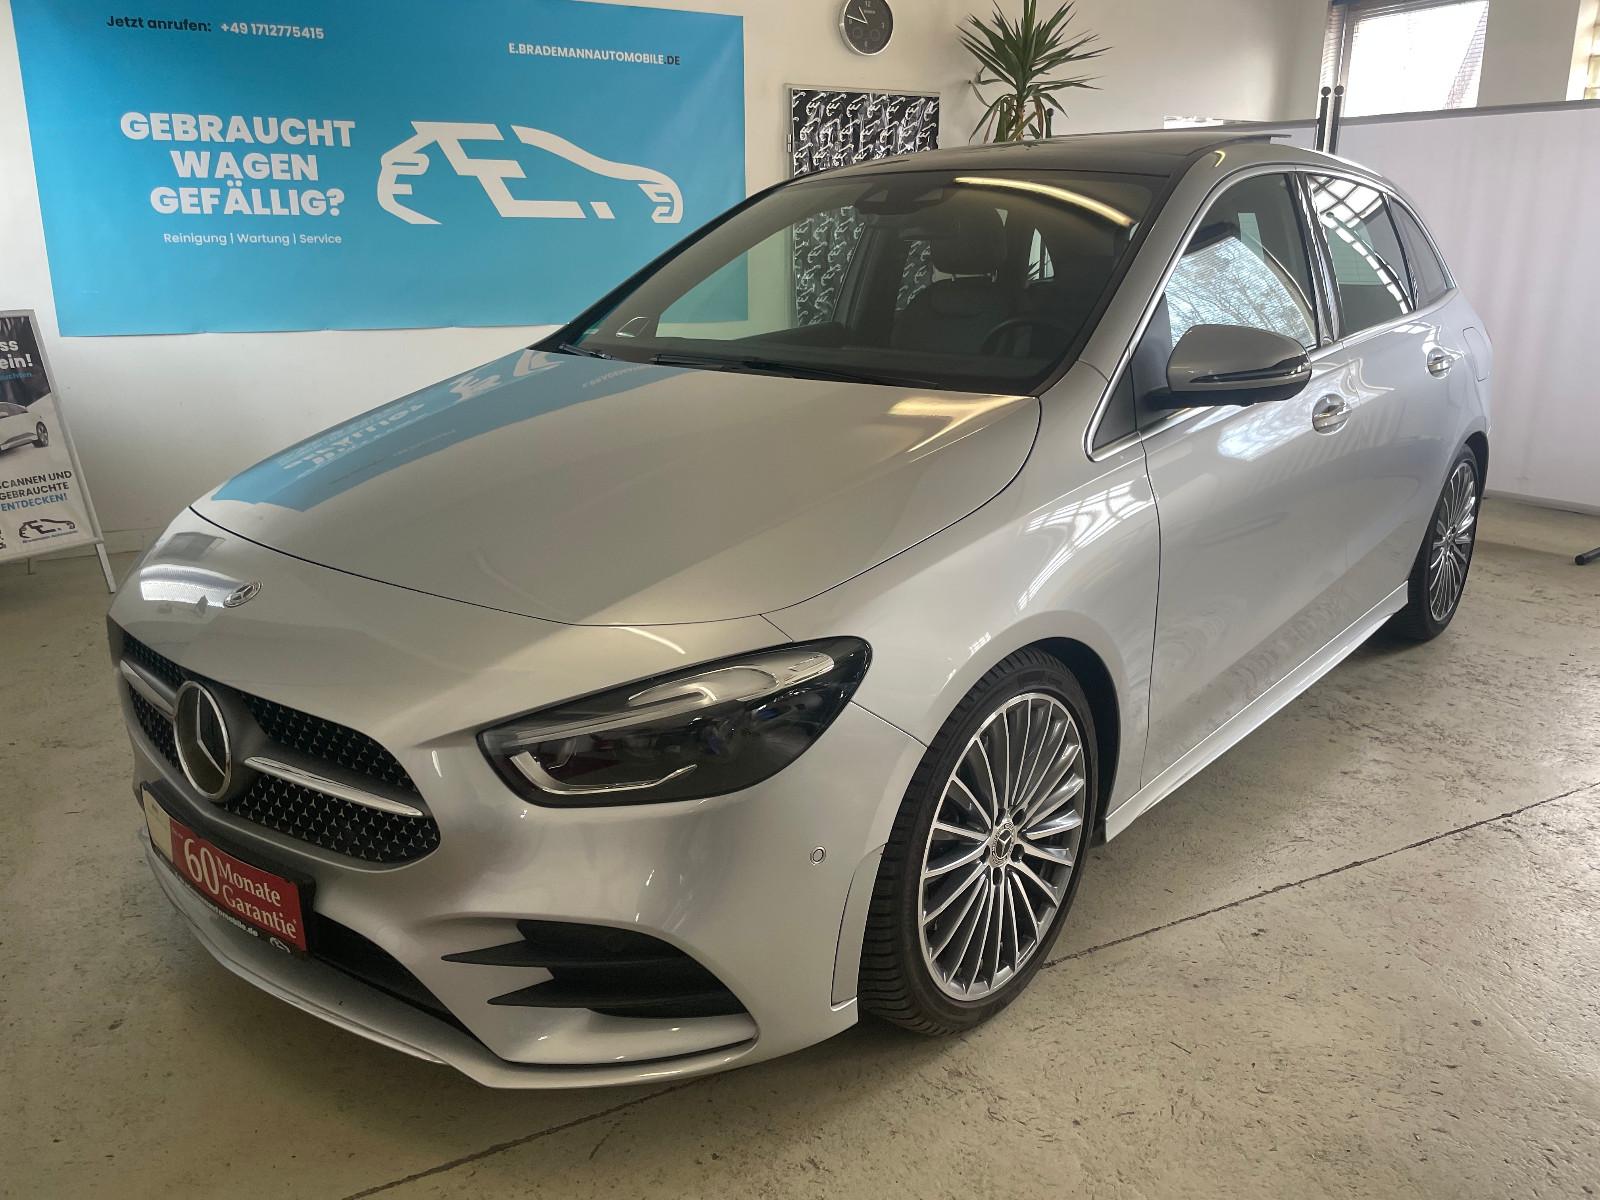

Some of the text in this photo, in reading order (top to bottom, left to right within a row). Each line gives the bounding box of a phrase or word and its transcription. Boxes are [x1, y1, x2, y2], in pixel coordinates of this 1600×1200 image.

[106, 15, 325, 40] Jetzt anrufen: +49 1712775415
[508, 43, 681, 66] E.BRADEMANNAUTOMOBILE.DE
[120, 111, 356, 148] GEBRAUCHT
[170, 150, 319, 182] WAGEN
[150, 179, 345, 217] GEFÄLLIG?
[163, 232, 343, 246] Reinigung Wartung Service
[0, 470, 73, 490] CANNEN UND
[0, 481, 70, 501] GEBRAUCHTE
[0, 492, 68, 512] ENTDECKEN!
[183, 838, 220, 895] 60
[216, 855, 281, 907] Monate
